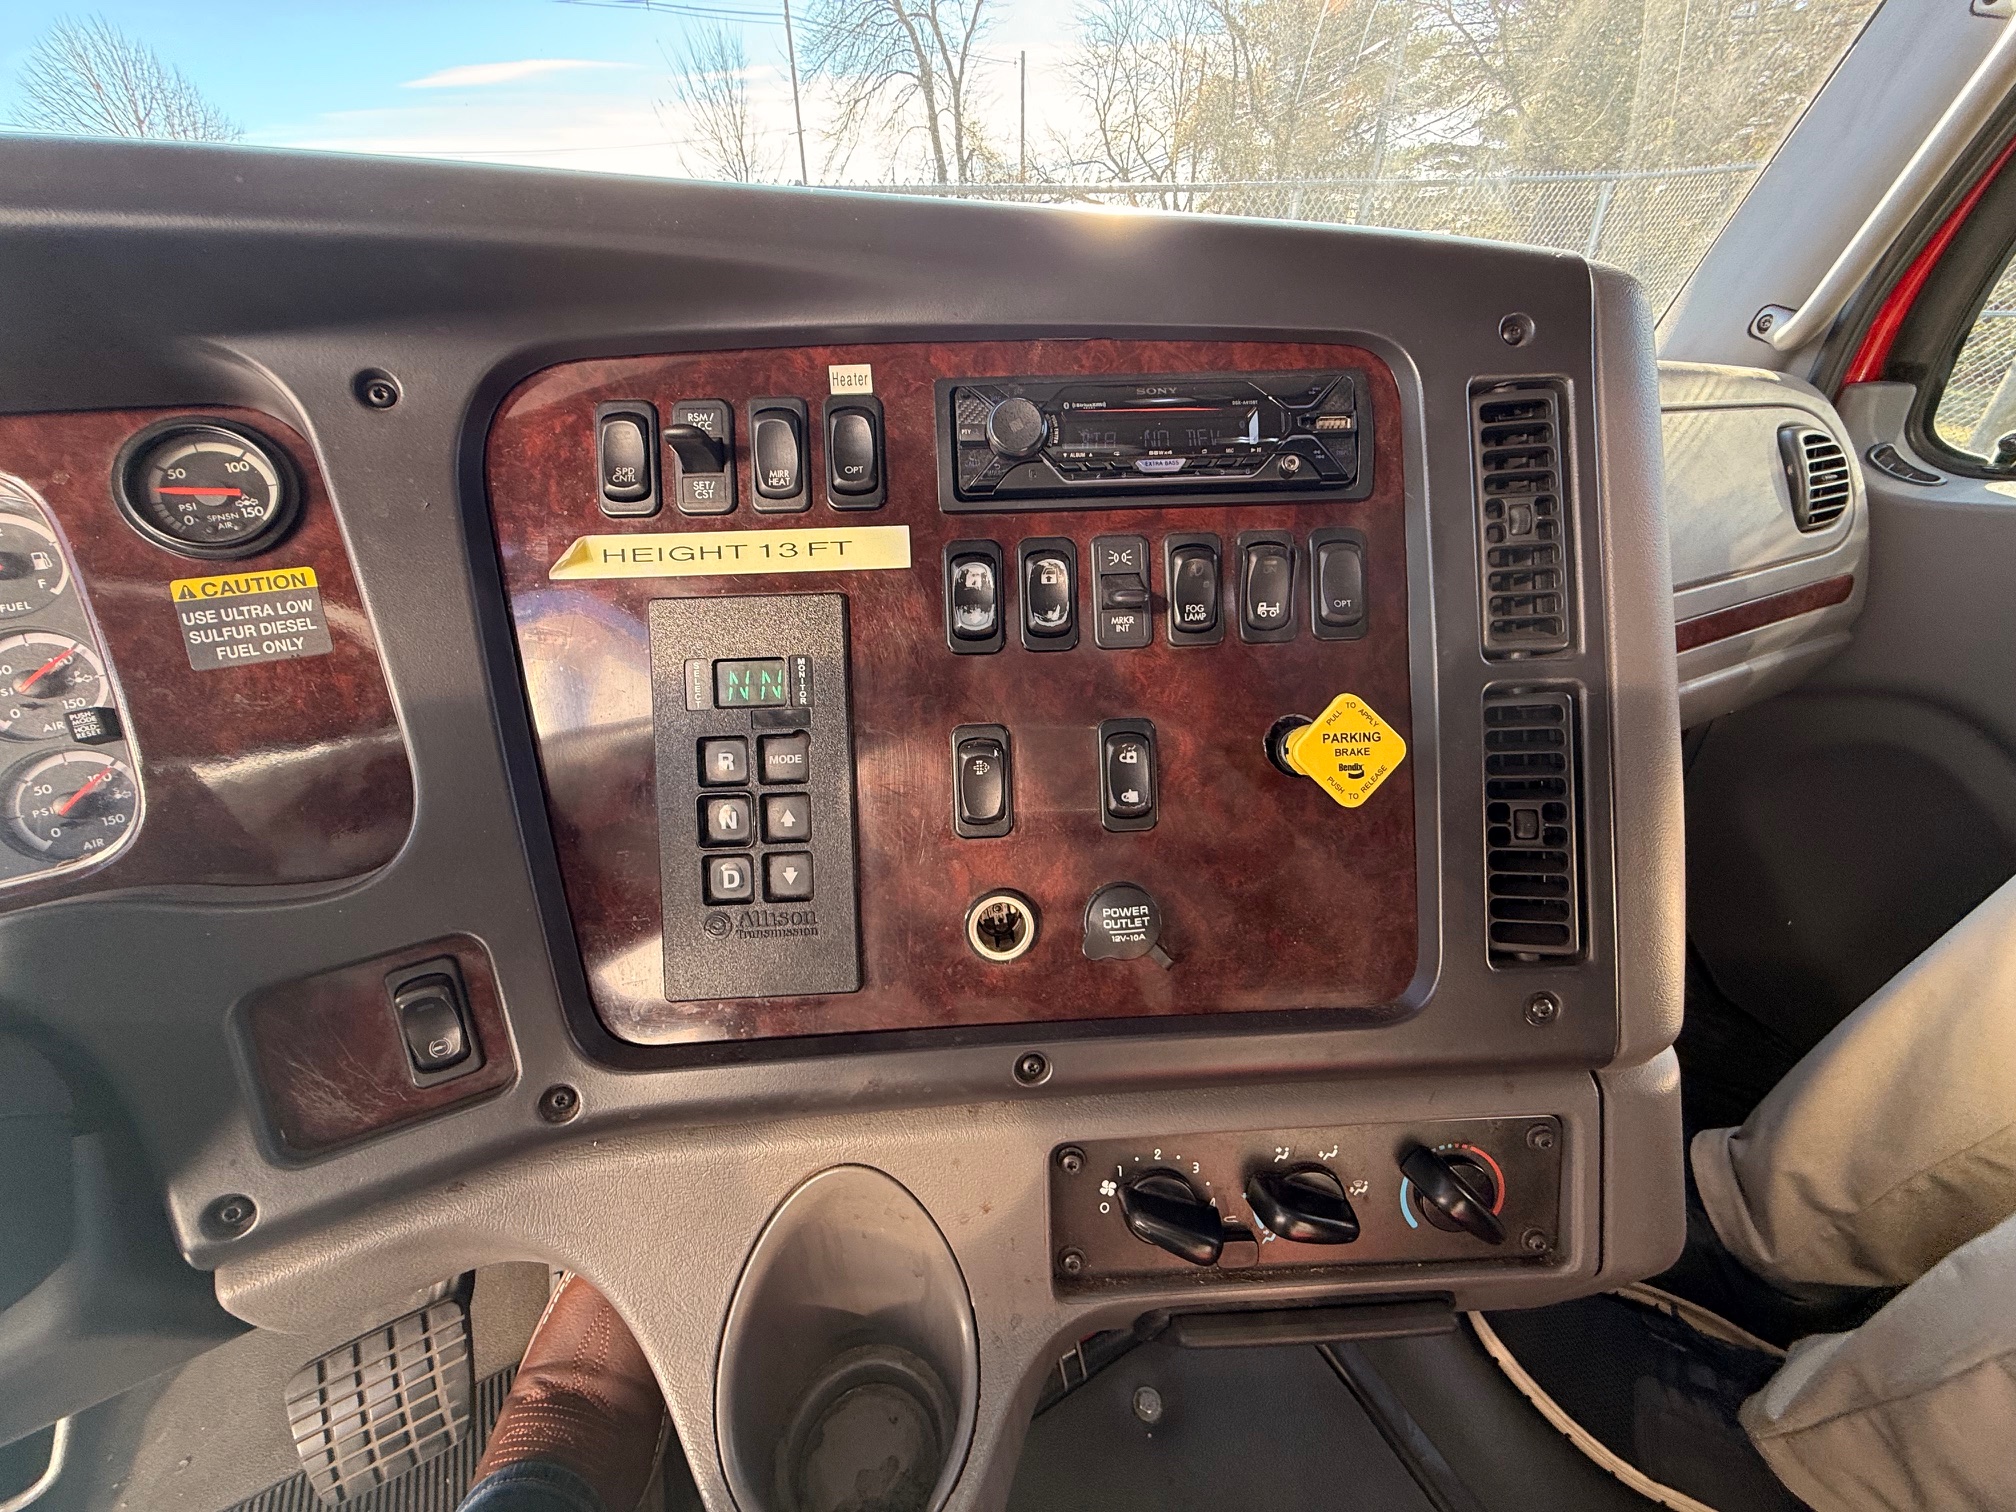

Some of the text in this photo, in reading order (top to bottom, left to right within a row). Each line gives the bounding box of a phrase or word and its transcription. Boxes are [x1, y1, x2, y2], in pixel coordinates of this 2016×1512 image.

[831, 371, 868, 387] Heater
[1136, 387, 1177, 395] SONY
[687, 412, 714, 422] RSM/
[225, 461, 250, 473] 100
[844, 466, 864, 474] OPT
[167, 468, 186, 480] 50
[612, 474, 636, 482] CNTL
[769, 469, 790, 478] MIRR
[692, 481, 715, 490] SET/
[768, 478, 791, 486] HEAT
[694, 490, 714, 499] CST
[178, 502, 197, 512] PSI
[240, 506, 264, 518] 150
[183, 515, 195, 525] 0
[206, 512, 239, 523] SPNSN
[217, 521, 234, 530] AIR
[602, 540, 853, 564] HEIGHT 13 FT
[37, 578, 47, 589] F
[200, 572, 308, 597] CAUTION
[0, 601, 32, 613] FUEL
[1185, 604, 1205, 613] FOG
[1333, 600, 1352, 608] OPT
[181, 598, 313, 626] USE ULTRA LOW
[1184, 613, 1207, 622] LAMP
[1111, 615, 1135, 625] MRKR
[188, 617, 318, 644] SULFUR DIESEL
[1115, 624, 1130, 632] INT
[215, 636, 304, 660] FUEL ONLY
[693, 661, 702, 709] SELECT
[797, 657, 807, 705] MONITOR
[0, 687, 14, 697] SI
[61, 697, 86, 710] 150
[9, 708, 21, 719] 0
[1326, 701, 1379, 728] PULL TO APPLY
[71, 715, 97, 725] MODE
[43, 721, 66, 733] AIR
[75, 729, 101, 740] RESET
[1322, 731, 1382, 744] PARKING
[1334, 747, 1371, 757] BRAKE
[717, 752, 735, 771] R
[769, 754, 802, 765] MODE
[1338, 762, 1364, 772] Bendix
[1326, 764, 1388, 800] PUSH TO RELEASE
[33, 784, 53, 797] 50
[31, 806, 54, 818] PSI
[101, 813, 126, 826] 150
[50, 827, 61, 838] 0
[82, 838, 106, 851] AIR
[722, 869, 740, 889] D
[1102, 905, 1149, 918] POWER
[737, 909, 818, 928] Allison
[1103, 916, 1150, 929] OUTLET
[735, 927, 819, 939] Transmission
[1111, 933, 1146, 943] 12V-10A
[1153, 1148, 1162, 1160] 2
[1117, 1165, 1123, 1177] 1
[1192, 1161, 1200, 1173] 3
